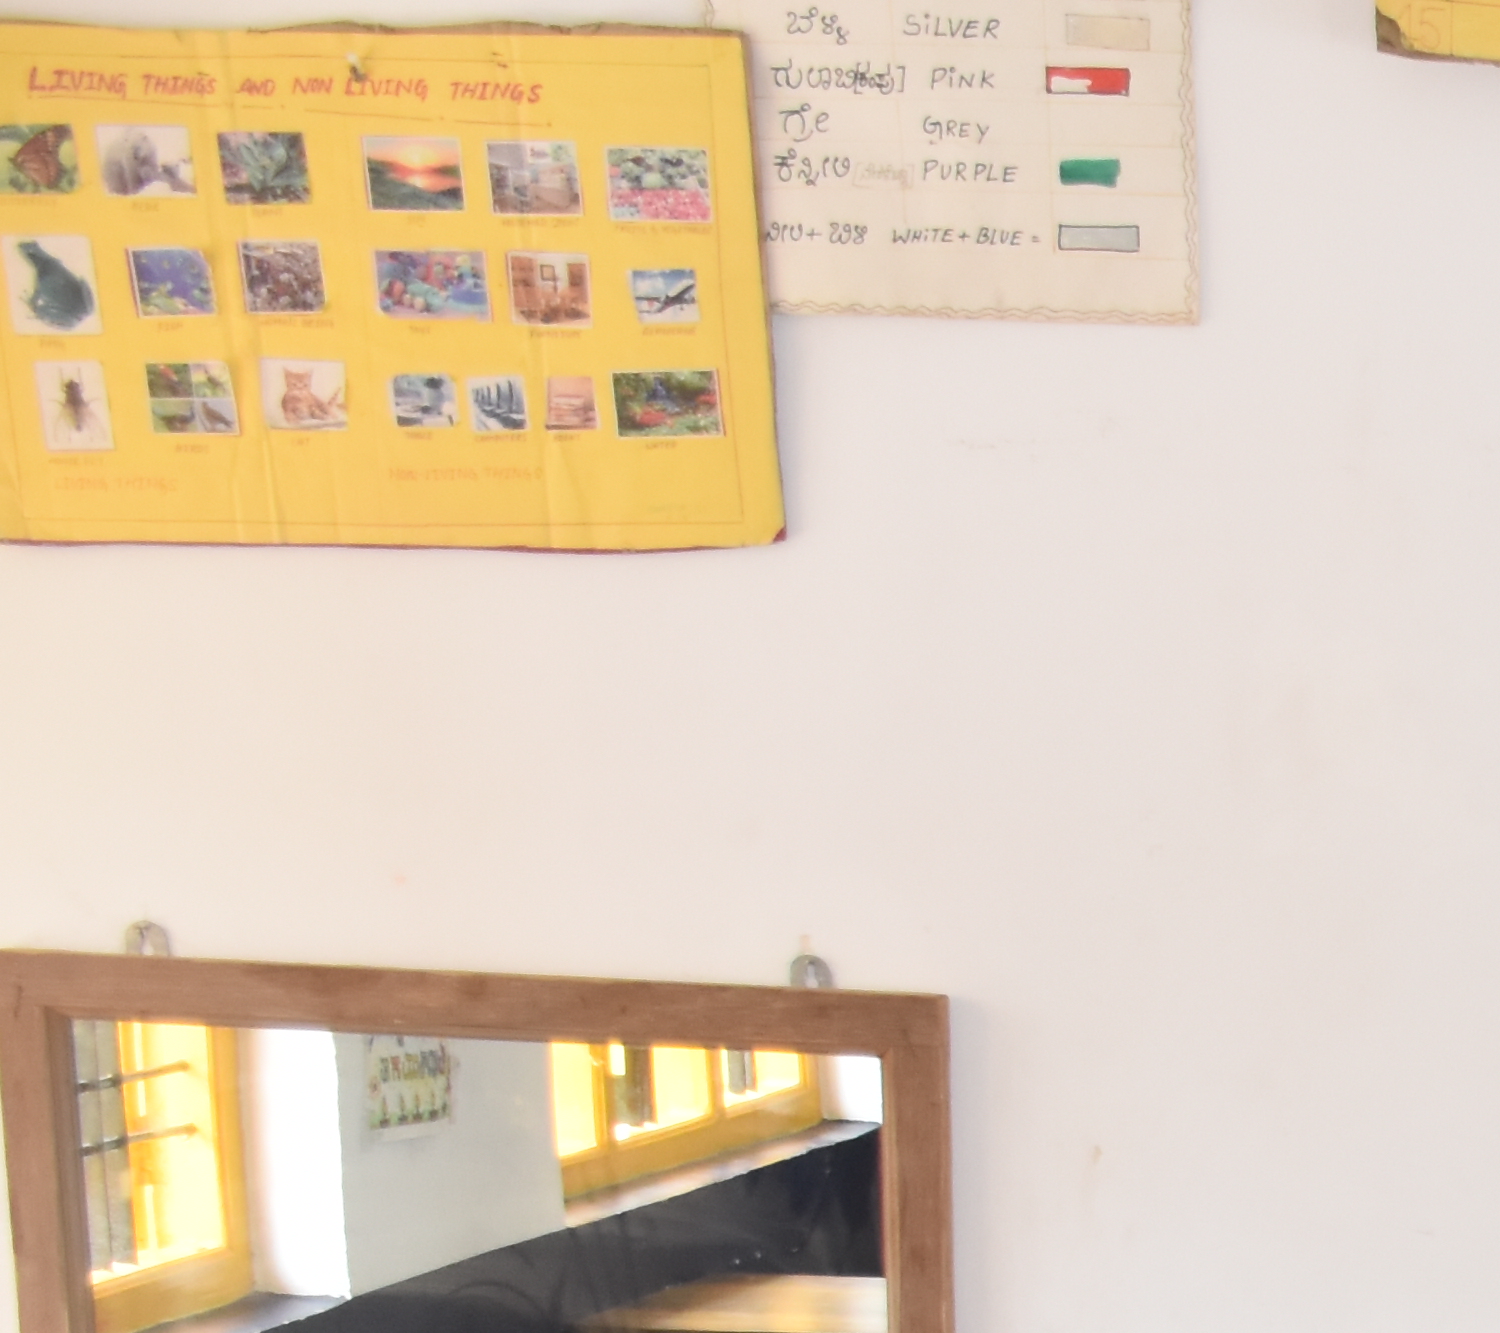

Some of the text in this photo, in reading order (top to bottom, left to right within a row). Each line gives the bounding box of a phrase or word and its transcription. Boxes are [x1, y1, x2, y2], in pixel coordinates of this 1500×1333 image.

[28, 66, 544, 105] LIVING THINGS AND NON LIVING THINGS
[922, 115, 990, 144] GREY
[922, 159, 1018, 184] PURPLE
[976, 227, 1024, 246] BLUE
